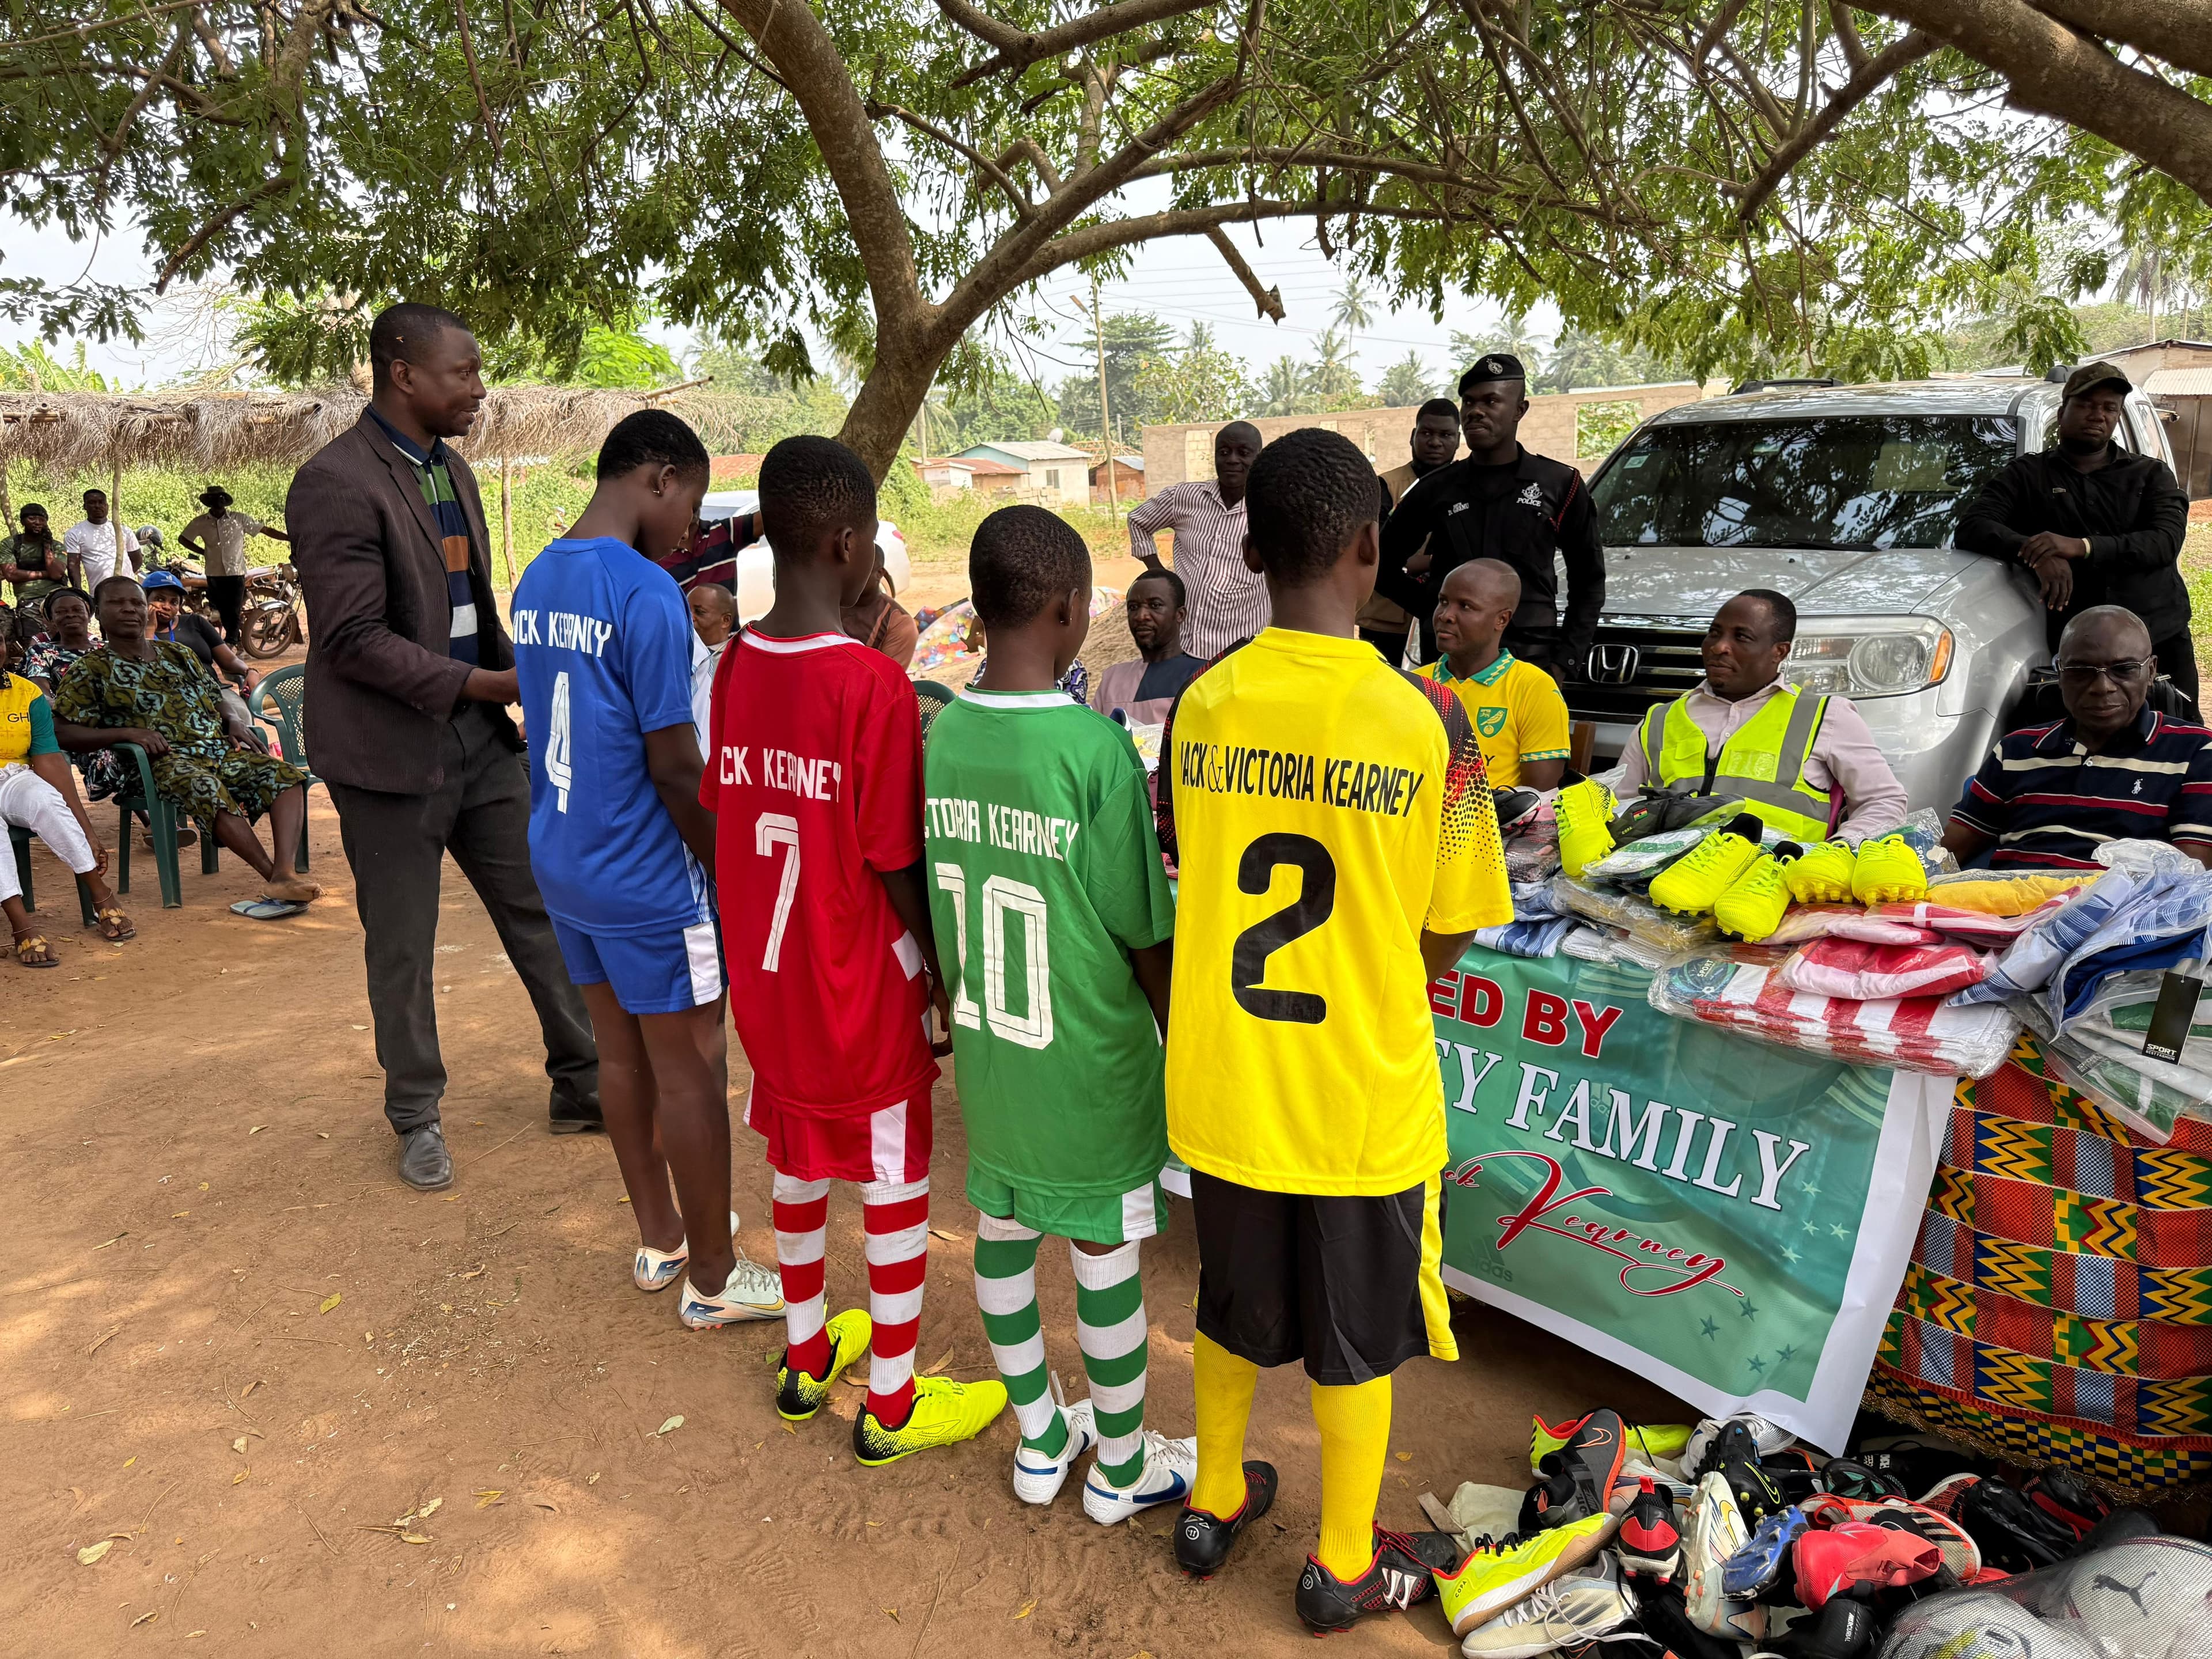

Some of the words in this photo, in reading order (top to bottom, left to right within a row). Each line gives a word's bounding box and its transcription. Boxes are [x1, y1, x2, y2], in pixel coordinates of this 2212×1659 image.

[1516, 497, 1541, 507] POLICE
[545, 671, 572, 814] 4
[1323, 757, 1424, 817] KEARNEY
[988, 803, 1080, 866] KEARNEY
[755, 812, 800, 973] 7
[934, 862, 1054, 1050] 10
[1232, 832, 1336, 1024] 2
[1697, 959, 1714, 978] SPORT
[1521, 987, 1624, 1059] BY
[2147, 1043, 2177, 1056] SPORT
[2156, 1053, 2175, 1061] FASHION
[1505, 1061, 1811, 1212] FAMILY
[1456, 1150, 1745, 1297] Kearney
[1455, 1581, 1467, 1598] COPA
[1844, 1612, 1854, 1642] MERCURIAL
